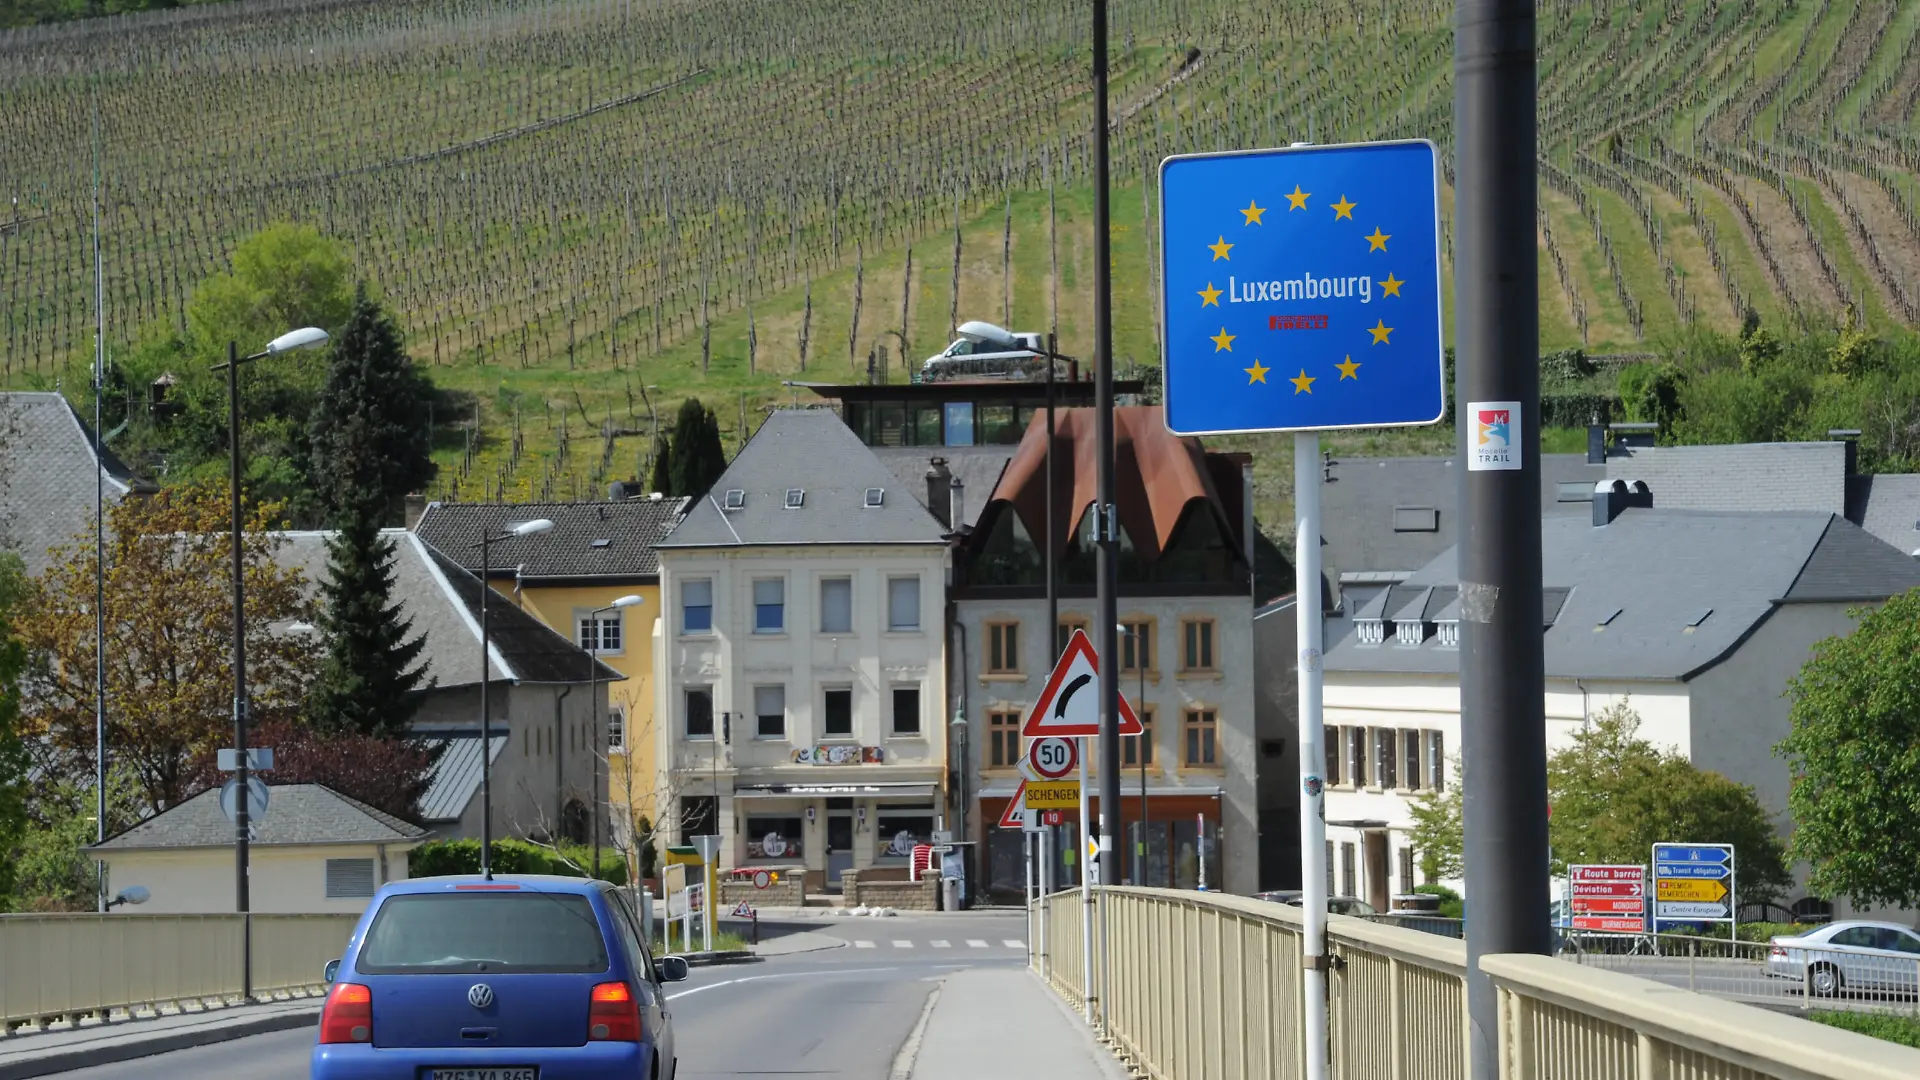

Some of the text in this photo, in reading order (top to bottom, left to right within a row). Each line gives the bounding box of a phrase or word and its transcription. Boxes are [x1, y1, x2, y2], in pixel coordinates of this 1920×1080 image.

[1229, 272, 1371, 304] Luxembourg
[1479, 454, 1510, 462] TRAIL
[1041, 744, 1065, 765] 50
[1028, 789, 1079, 801] SCHENGEN
[1048, 813, 1058, 823] 10
[1584, 869, 1641, 879] Route barrée
[1573, 885, 1613, 893] Déviation
[1612, 901, 1641, 911] MONDORF
[503, 1071, 533, 1080] 865
